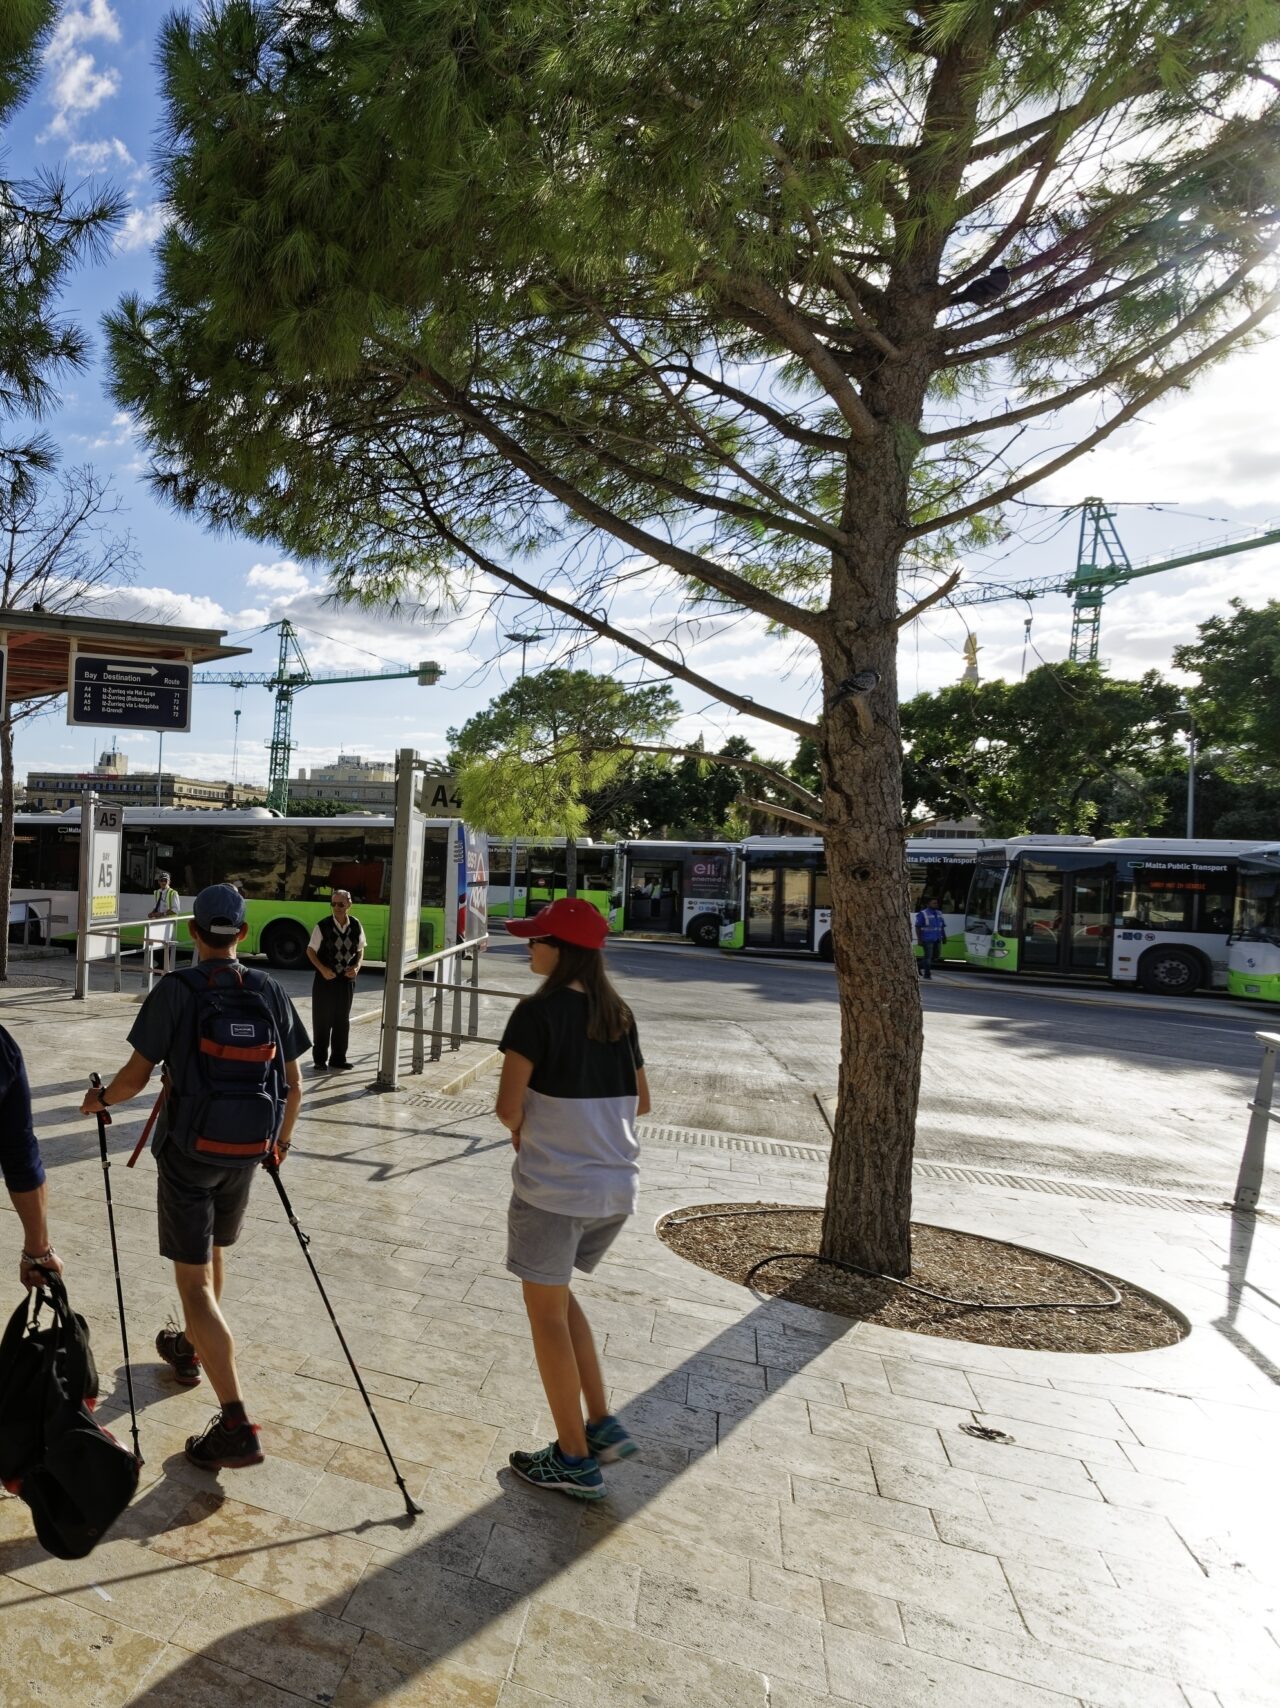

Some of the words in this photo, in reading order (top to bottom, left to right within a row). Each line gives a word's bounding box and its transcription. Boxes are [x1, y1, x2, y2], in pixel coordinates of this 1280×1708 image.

[84, 672, 97, 680] Bay
[103, 673, 140, 682] Destination
[431, 785, 464, 808] A4
[100, 813, 116, 826] A5
[1191, 864, 1227, 872] Transport
[98, 863, 112, 888] A5
